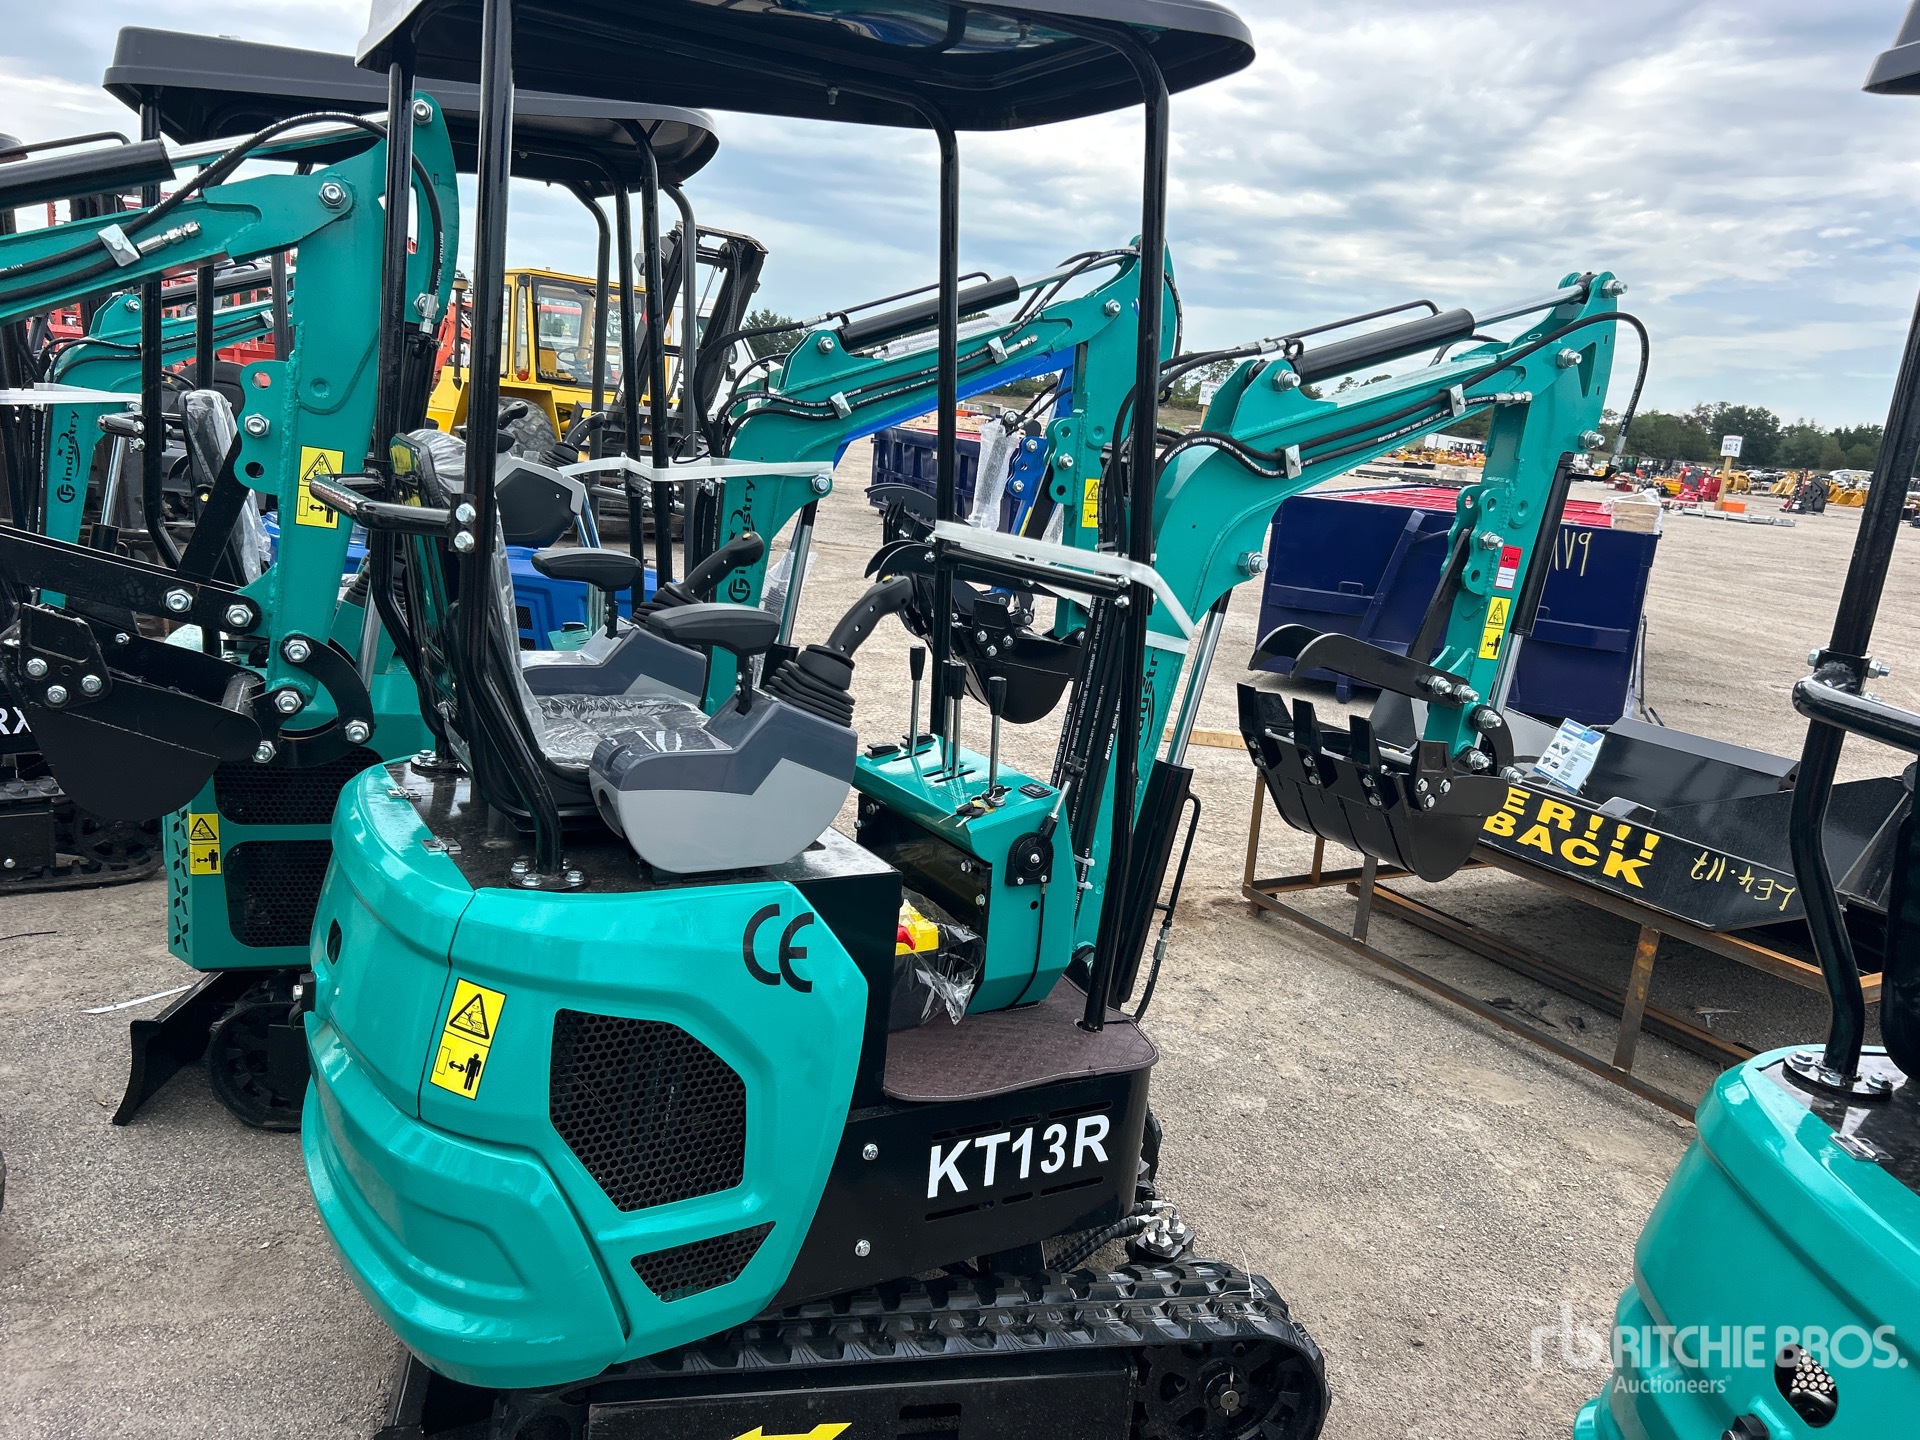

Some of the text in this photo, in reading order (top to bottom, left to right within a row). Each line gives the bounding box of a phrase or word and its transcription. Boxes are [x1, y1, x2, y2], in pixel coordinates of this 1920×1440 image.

[1483, 811, 1650, 888] BACK
[743, 903, 814, 993] CE
[927, 1115, 1110, 1198] KT13R
